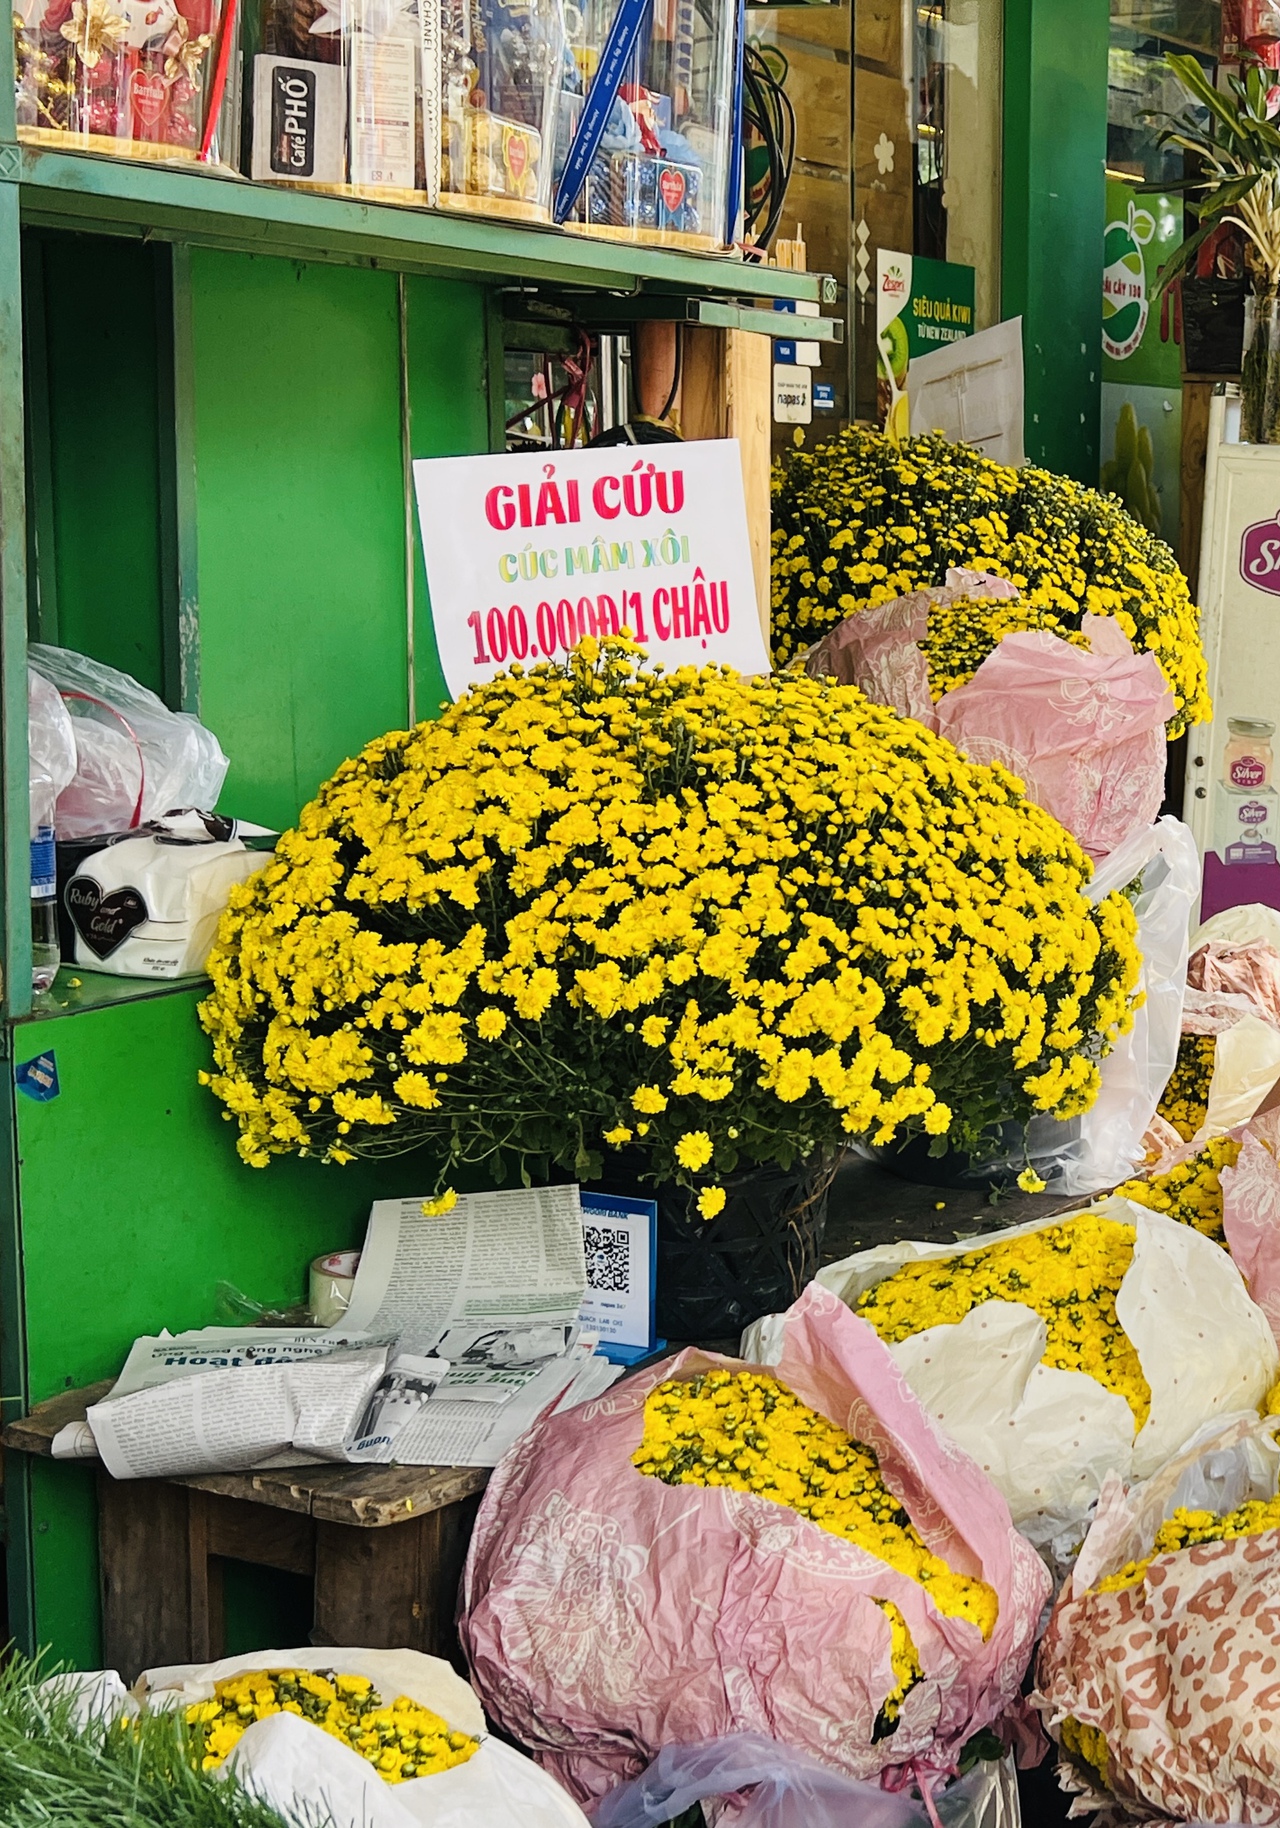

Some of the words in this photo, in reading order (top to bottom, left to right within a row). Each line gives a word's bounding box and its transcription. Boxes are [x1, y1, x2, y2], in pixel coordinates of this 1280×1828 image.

[422, 0, 433, 53] CHANEL
[278, 77, 308, 136] PHỐ
[290, 135, 306, 167] Café
[933, 297, 951, 323] QUẢ
[952, 304, 971, 324] KIWI
[926, 326, 940, 340] NEW
[777, 392, 800, 408] napas
[485, 464, 581, 531] GIẢI
[592, 459, 685, 520] CỨU
[498, 543, 559, 583] CÚC
[564, 535, 635, 576] MÂM
[640, 527, 691, 567] XÔI
[652, 566, 730, 649] CHẬU
[1232, 766, 1262, 780] Silver
[1240, 808, 1266, 820] Silver
[70, 888, 100, 912] Ruby
[90, 916, 118, 934] Gold
